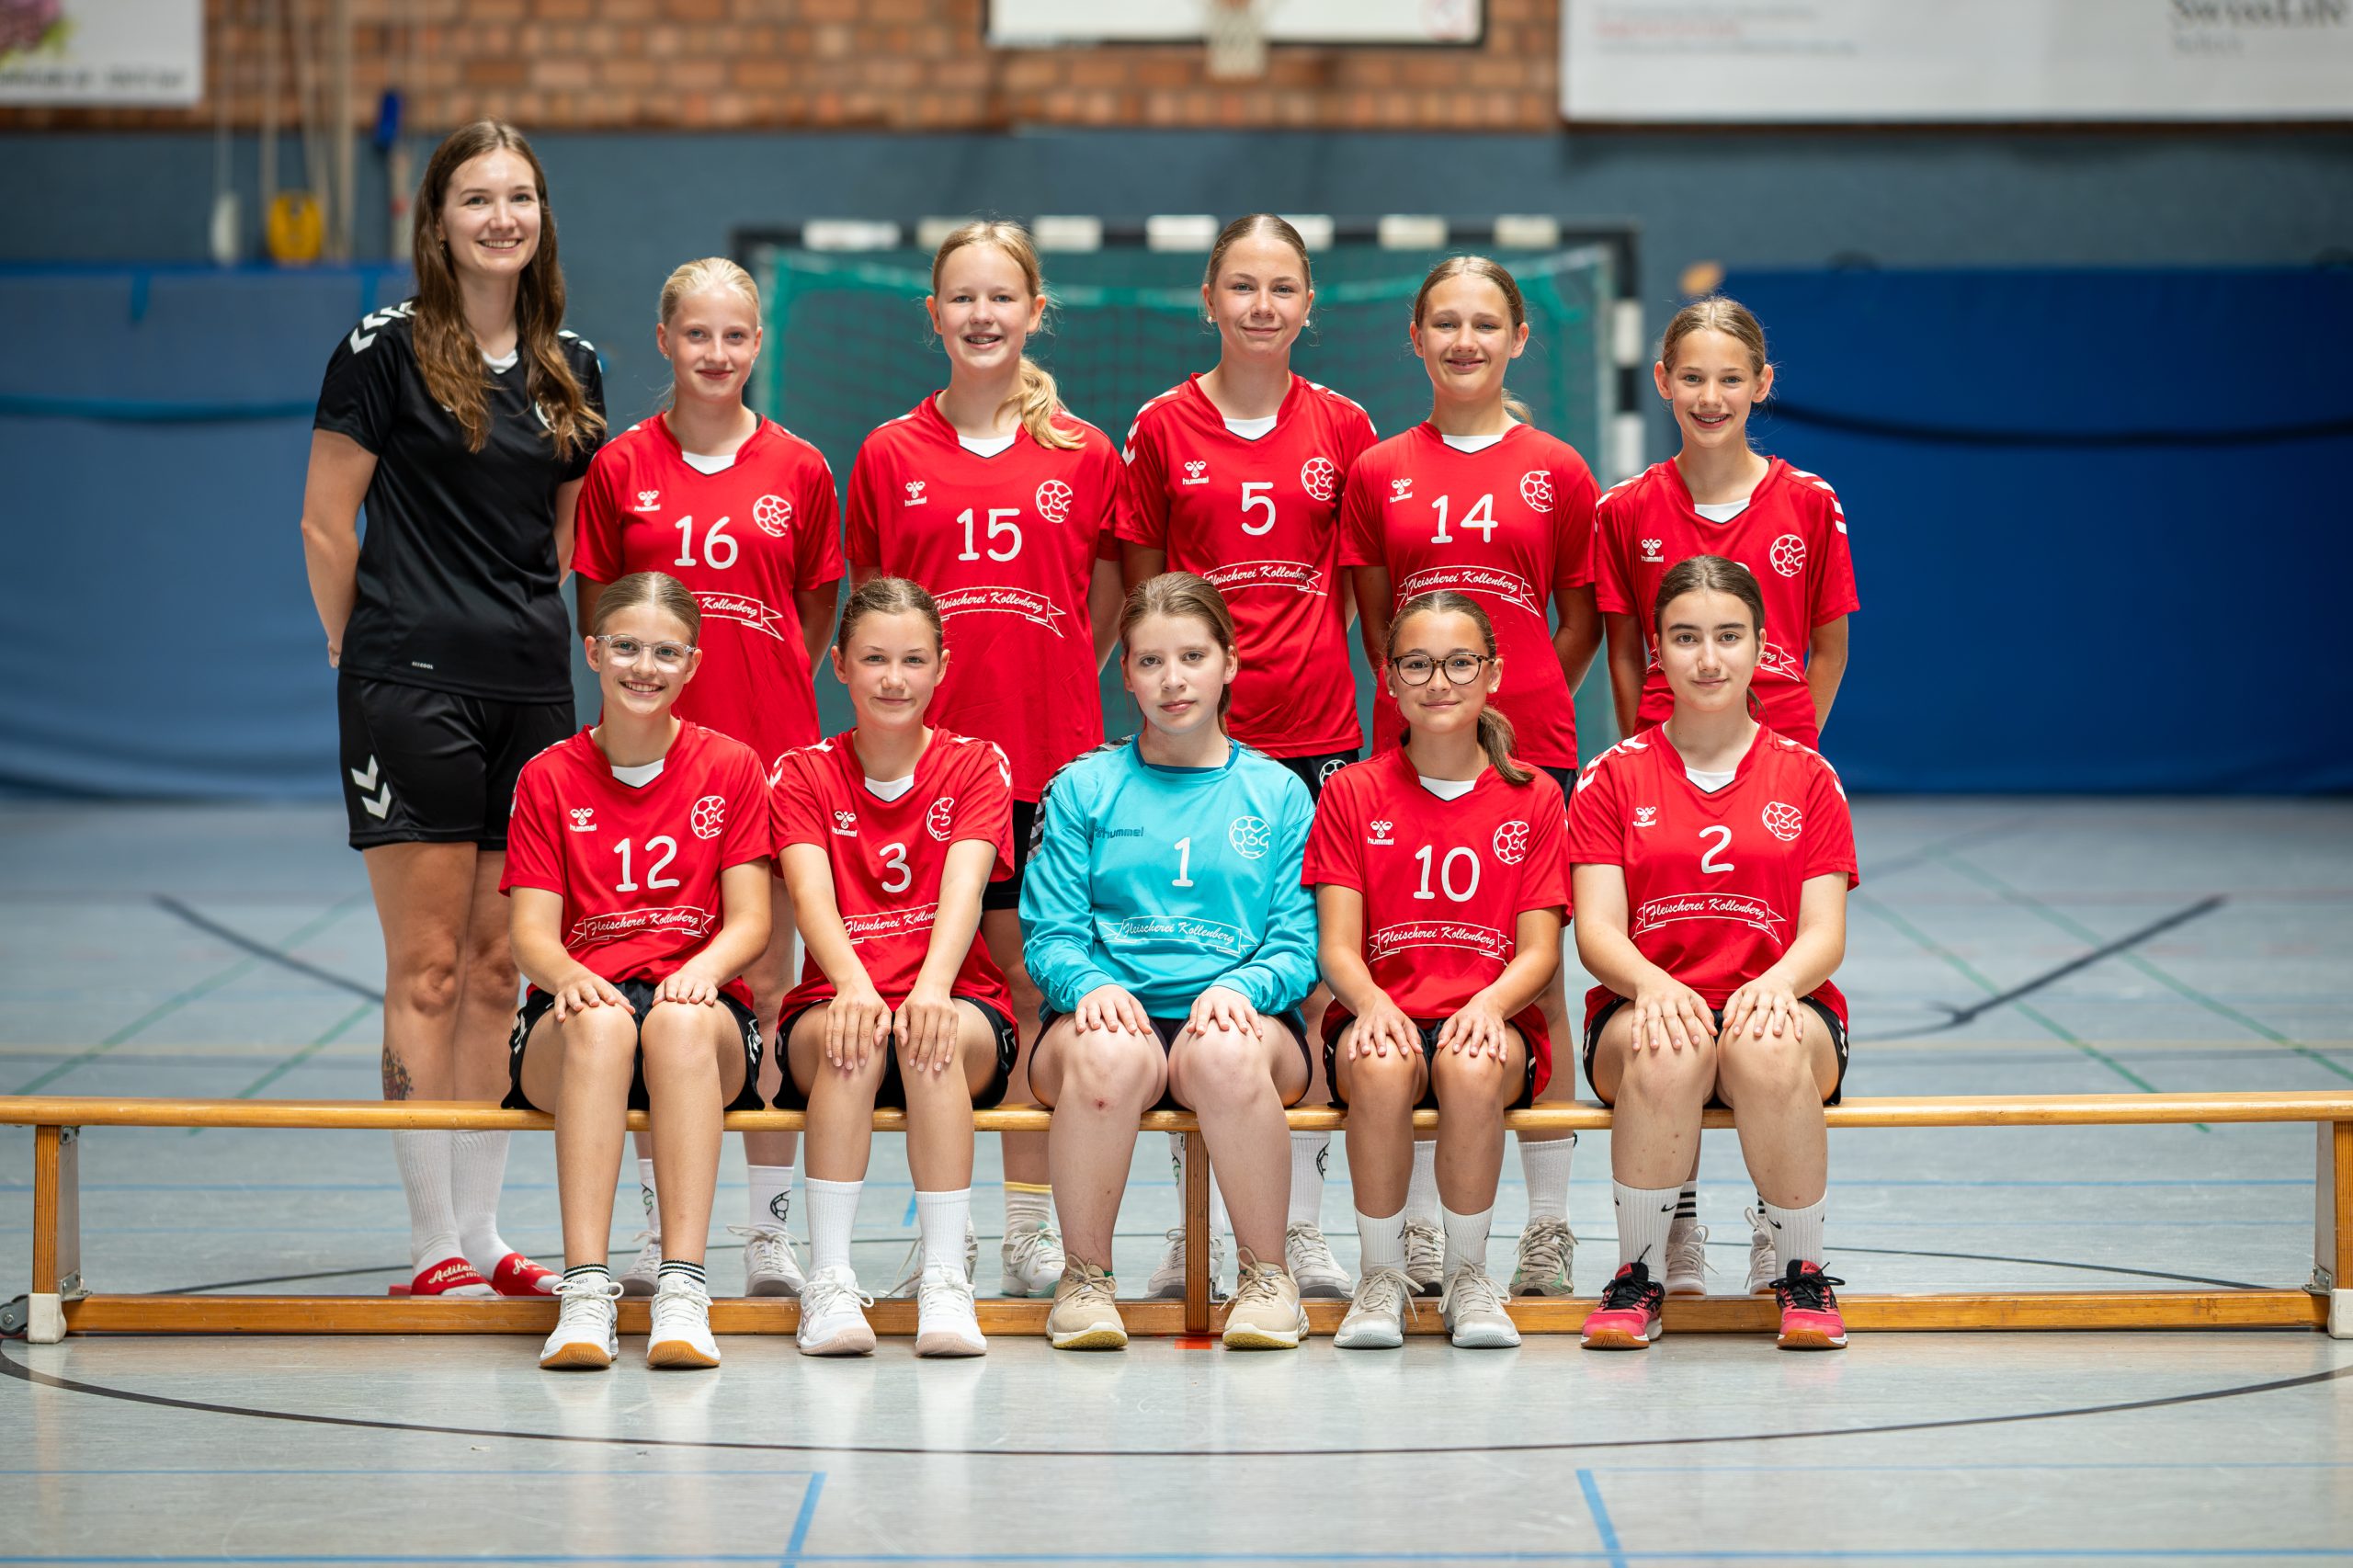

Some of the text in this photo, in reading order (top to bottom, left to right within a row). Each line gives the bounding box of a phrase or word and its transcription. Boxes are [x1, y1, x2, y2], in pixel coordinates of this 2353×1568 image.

[1182, 476, 1210, 485] hummel
[1241, 482, 1276, 536] 5
[1431, 494, 1498, 543] 14
[674, 515, 739, 570] 16
[956, 508, 1022, 562] 15
[1408, 571, 1518, 595] Fleischerei Kollenberg
[701, 597, 757, 619] Kollenberg
[990, 591, 1043, 614] Kollenberg
[569, 823, 597, 833] hummel
[832, 825, 858, 837] hummel
[1103, 826, 1144, 839] hummel
[1368, 836, 1394, 846] hummel
[1699, 825, 1734, 874] 2
[613, 835, 680, 892] 12
[879, 842, 912, 893] 3
[1172, 837, 1194, 887] 1
[1414, 845, 1481, 903] 10
[1646, 898, 1765, 921] Fleischerei Kollenberg
[587, 916, 646, 936] Fleischerei
[845, 917, 900, 936] Fleischerei
[1123, 920, 1235, 946] Fleischerei Kollenberg
[1381, 926, 1495, 949] Fleischerei Kollenberg
